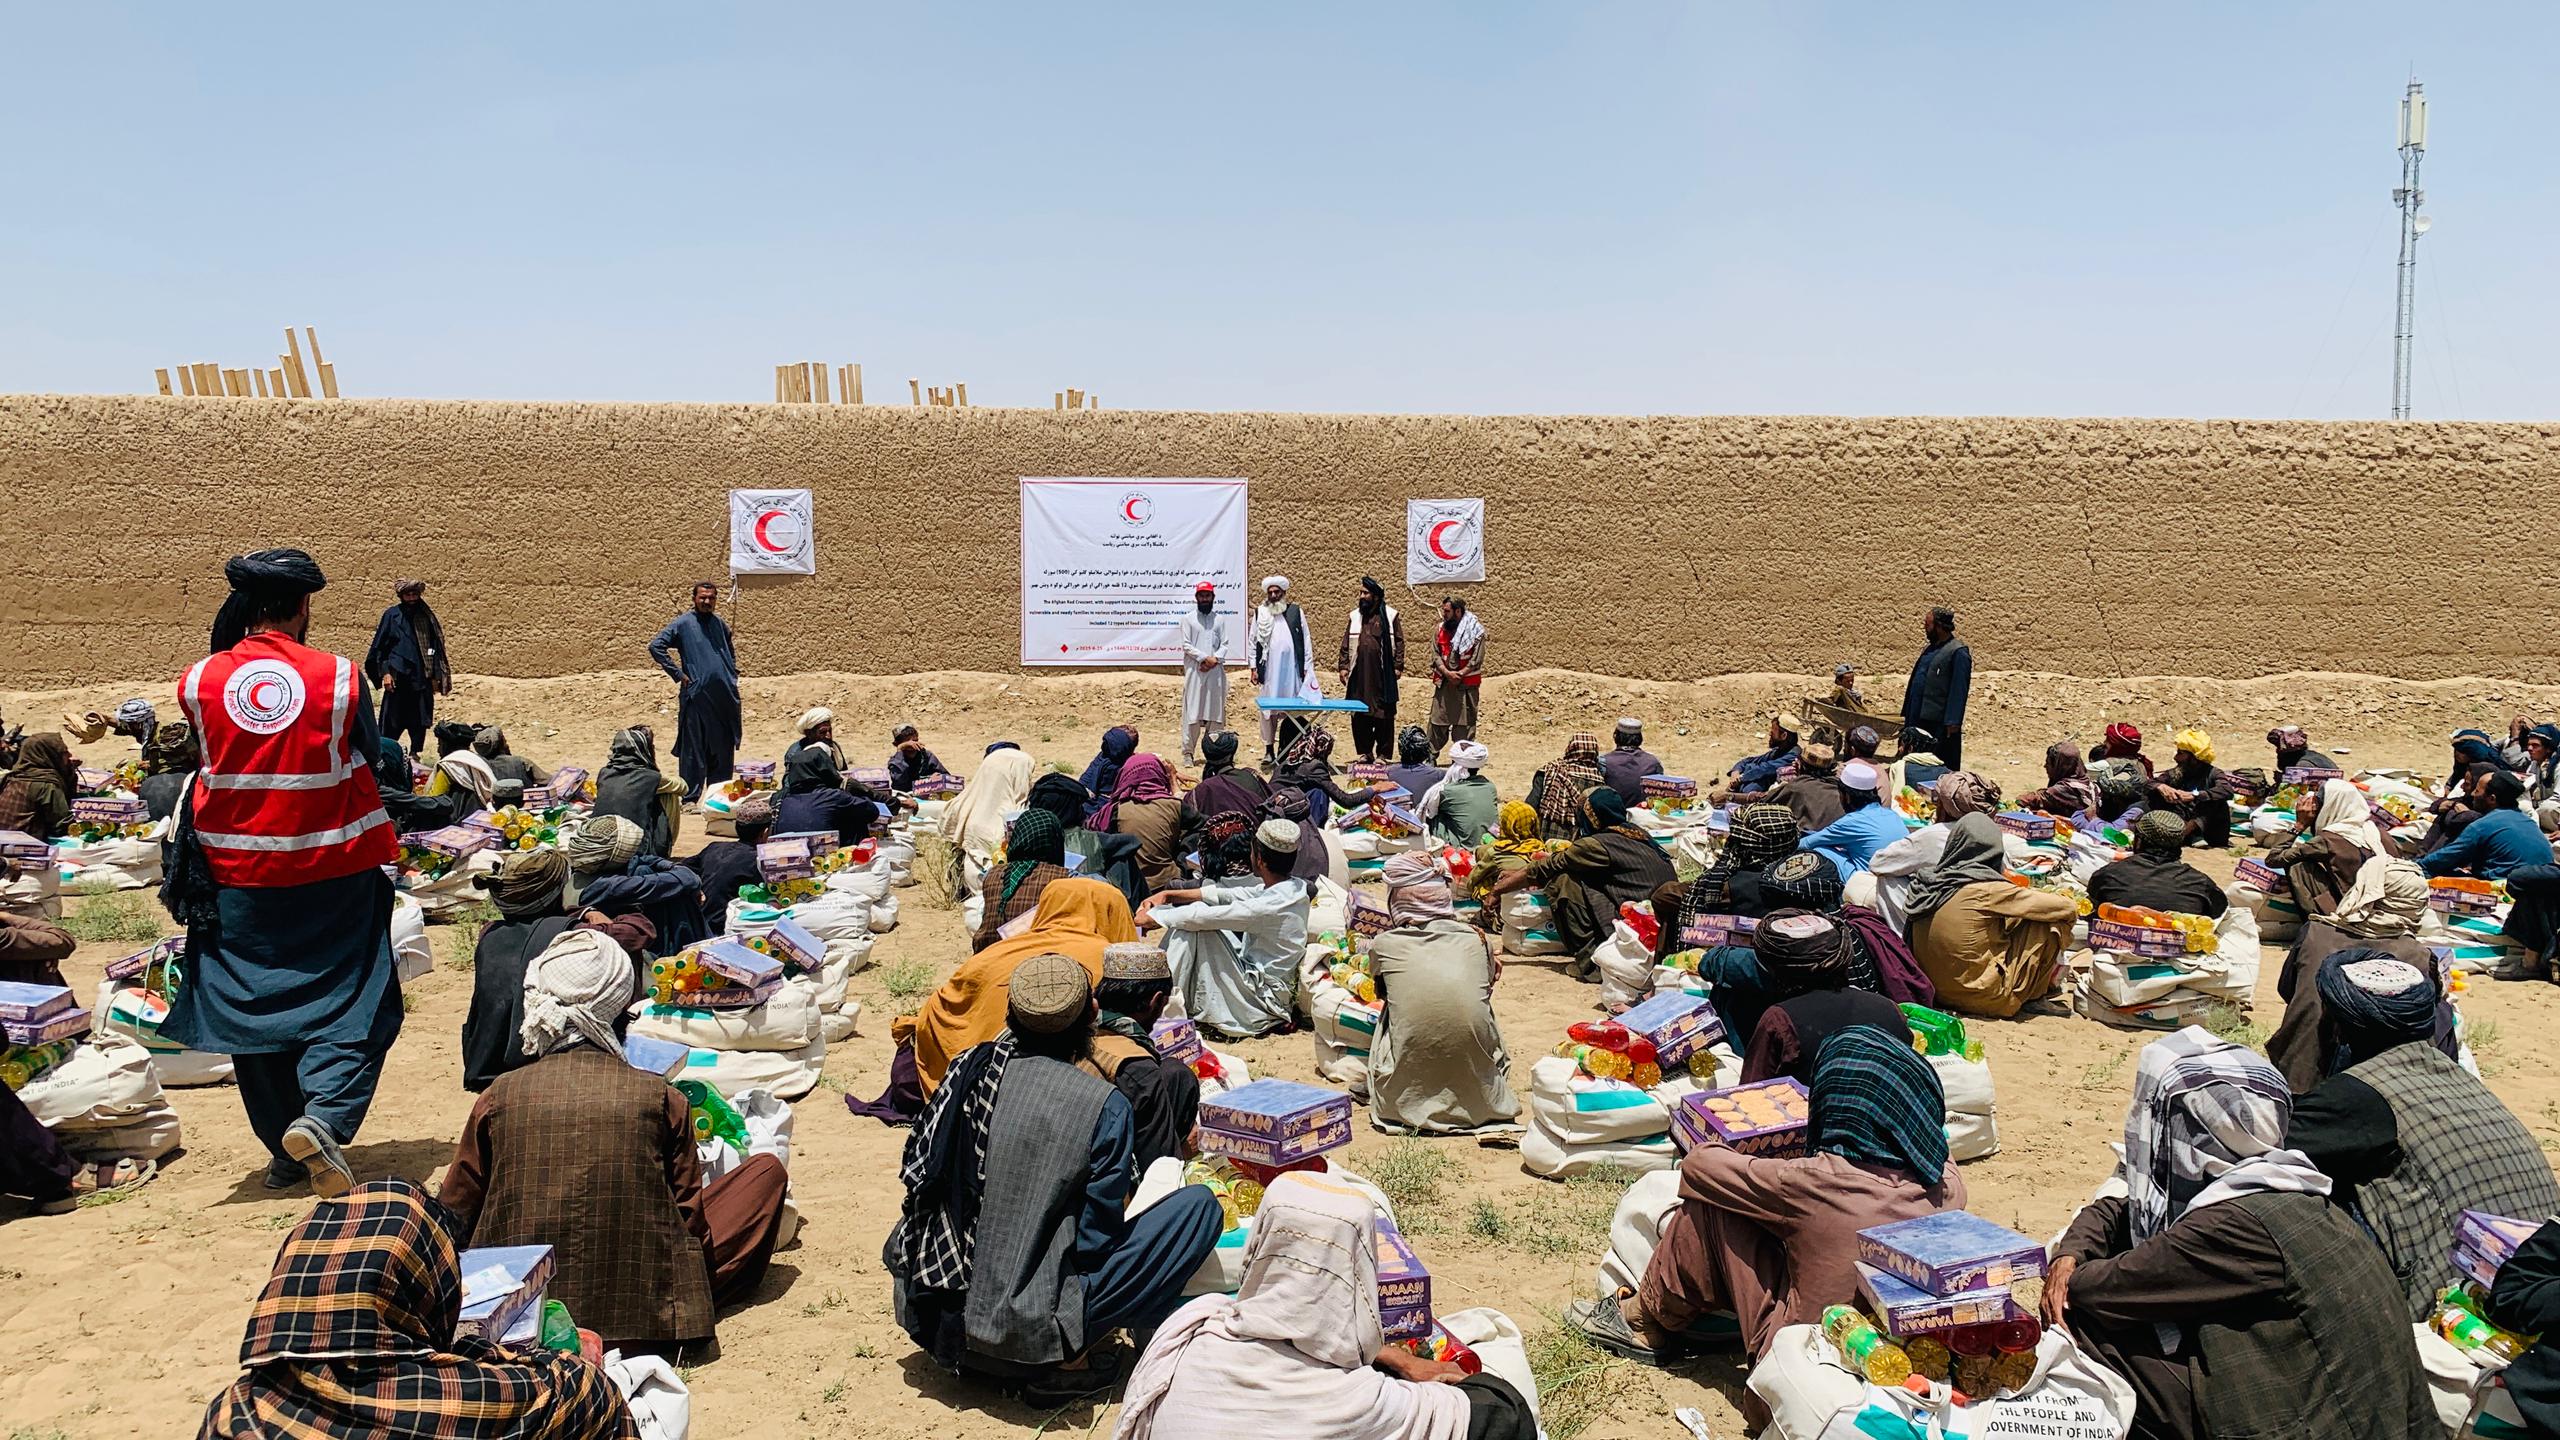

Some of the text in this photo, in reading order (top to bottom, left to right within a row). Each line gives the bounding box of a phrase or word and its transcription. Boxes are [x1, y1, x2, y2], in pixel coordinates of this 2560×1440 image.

[234, 711, 260, 730] Disaster
[262, 714, 290, 730] Response
[288, 698, 300, 714] Team
[2024, 1407, 2068, 1421] PEOPLE
[2075, 1411, 2096, 1422] AND
[2066, 1427, 2082, 1438] OF
